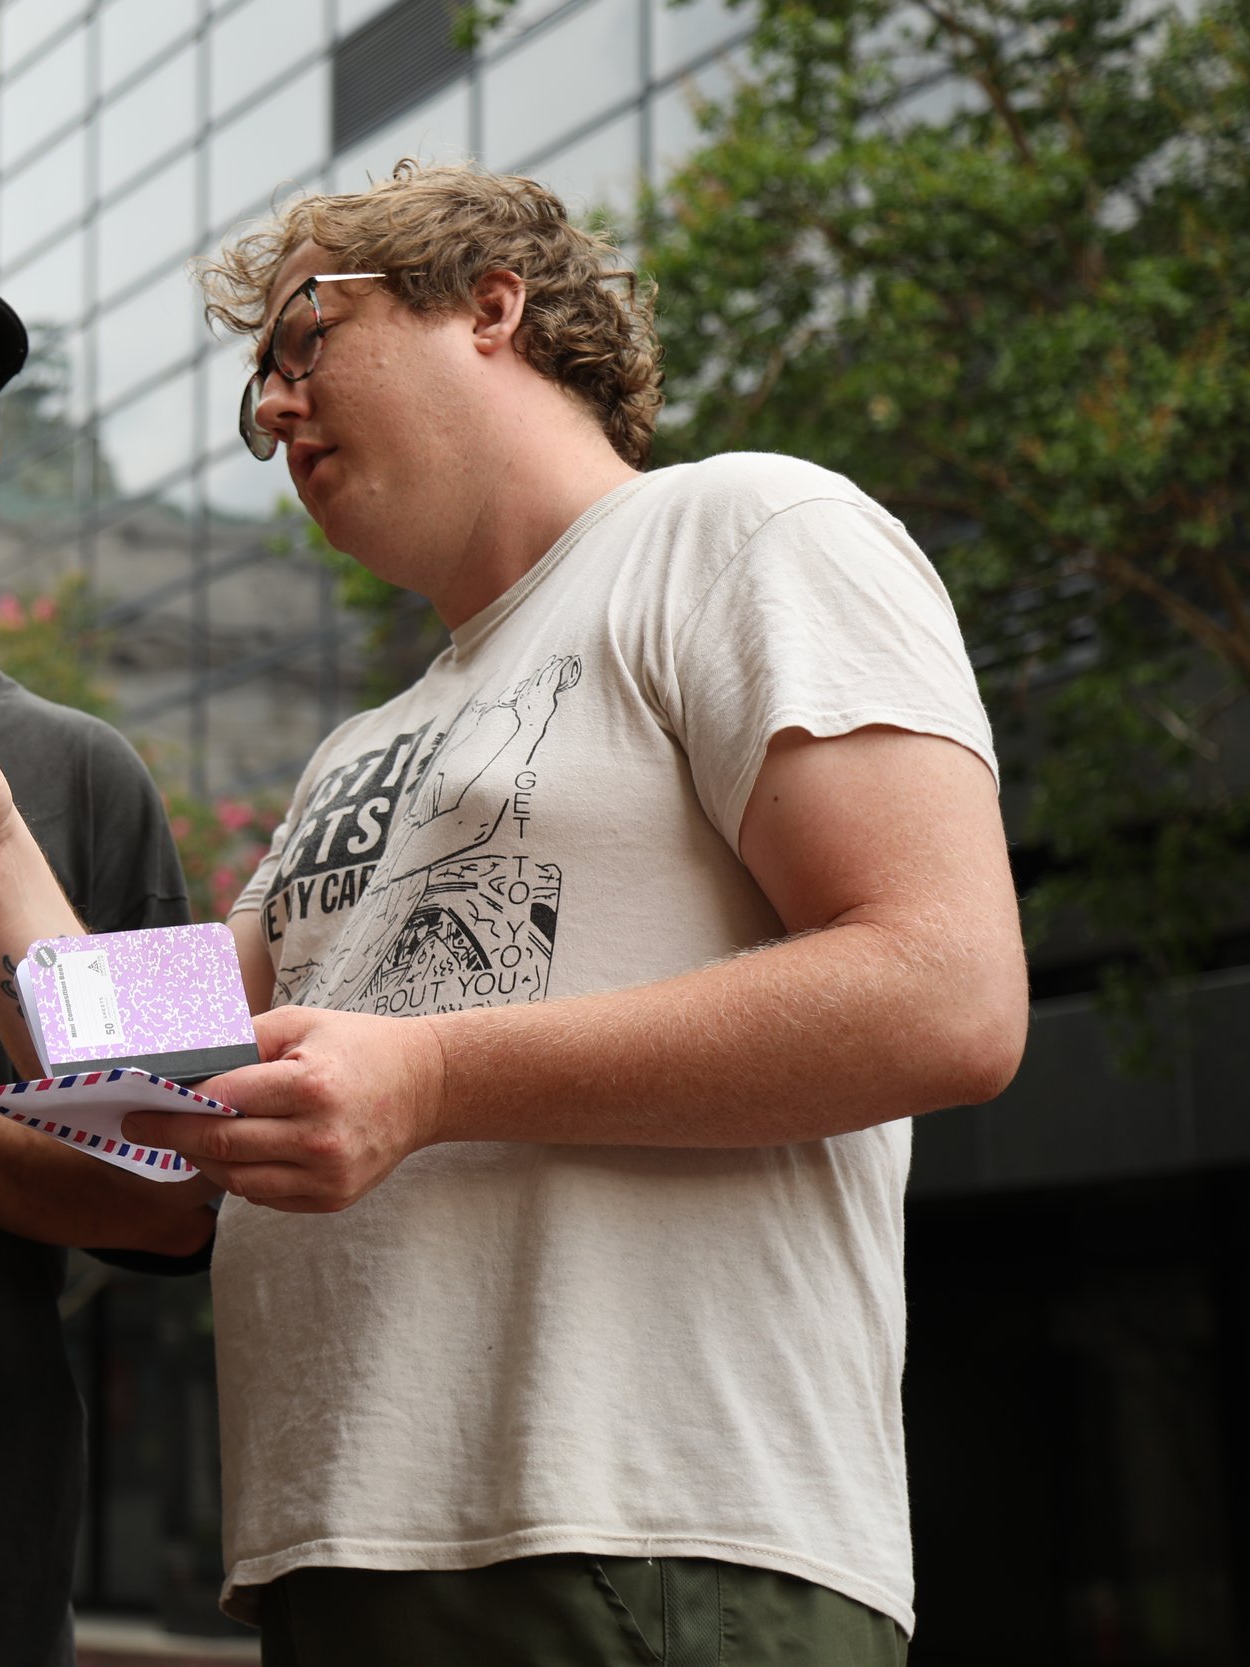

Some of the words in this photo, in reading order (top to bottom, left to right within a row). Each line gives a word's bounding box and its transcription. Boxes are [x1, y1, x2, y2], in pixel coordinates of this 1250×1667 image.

[513, 770, 537, 839] GET
[281, 797, 391, 878] CTS
[508, 856, 530, 905] TO
[57, 964, 65, 980] Book
[458, 971, 517, 998] YOU
[61, 981, 74, 1021] Composition
[104, 1022, 116, 1035] 50
